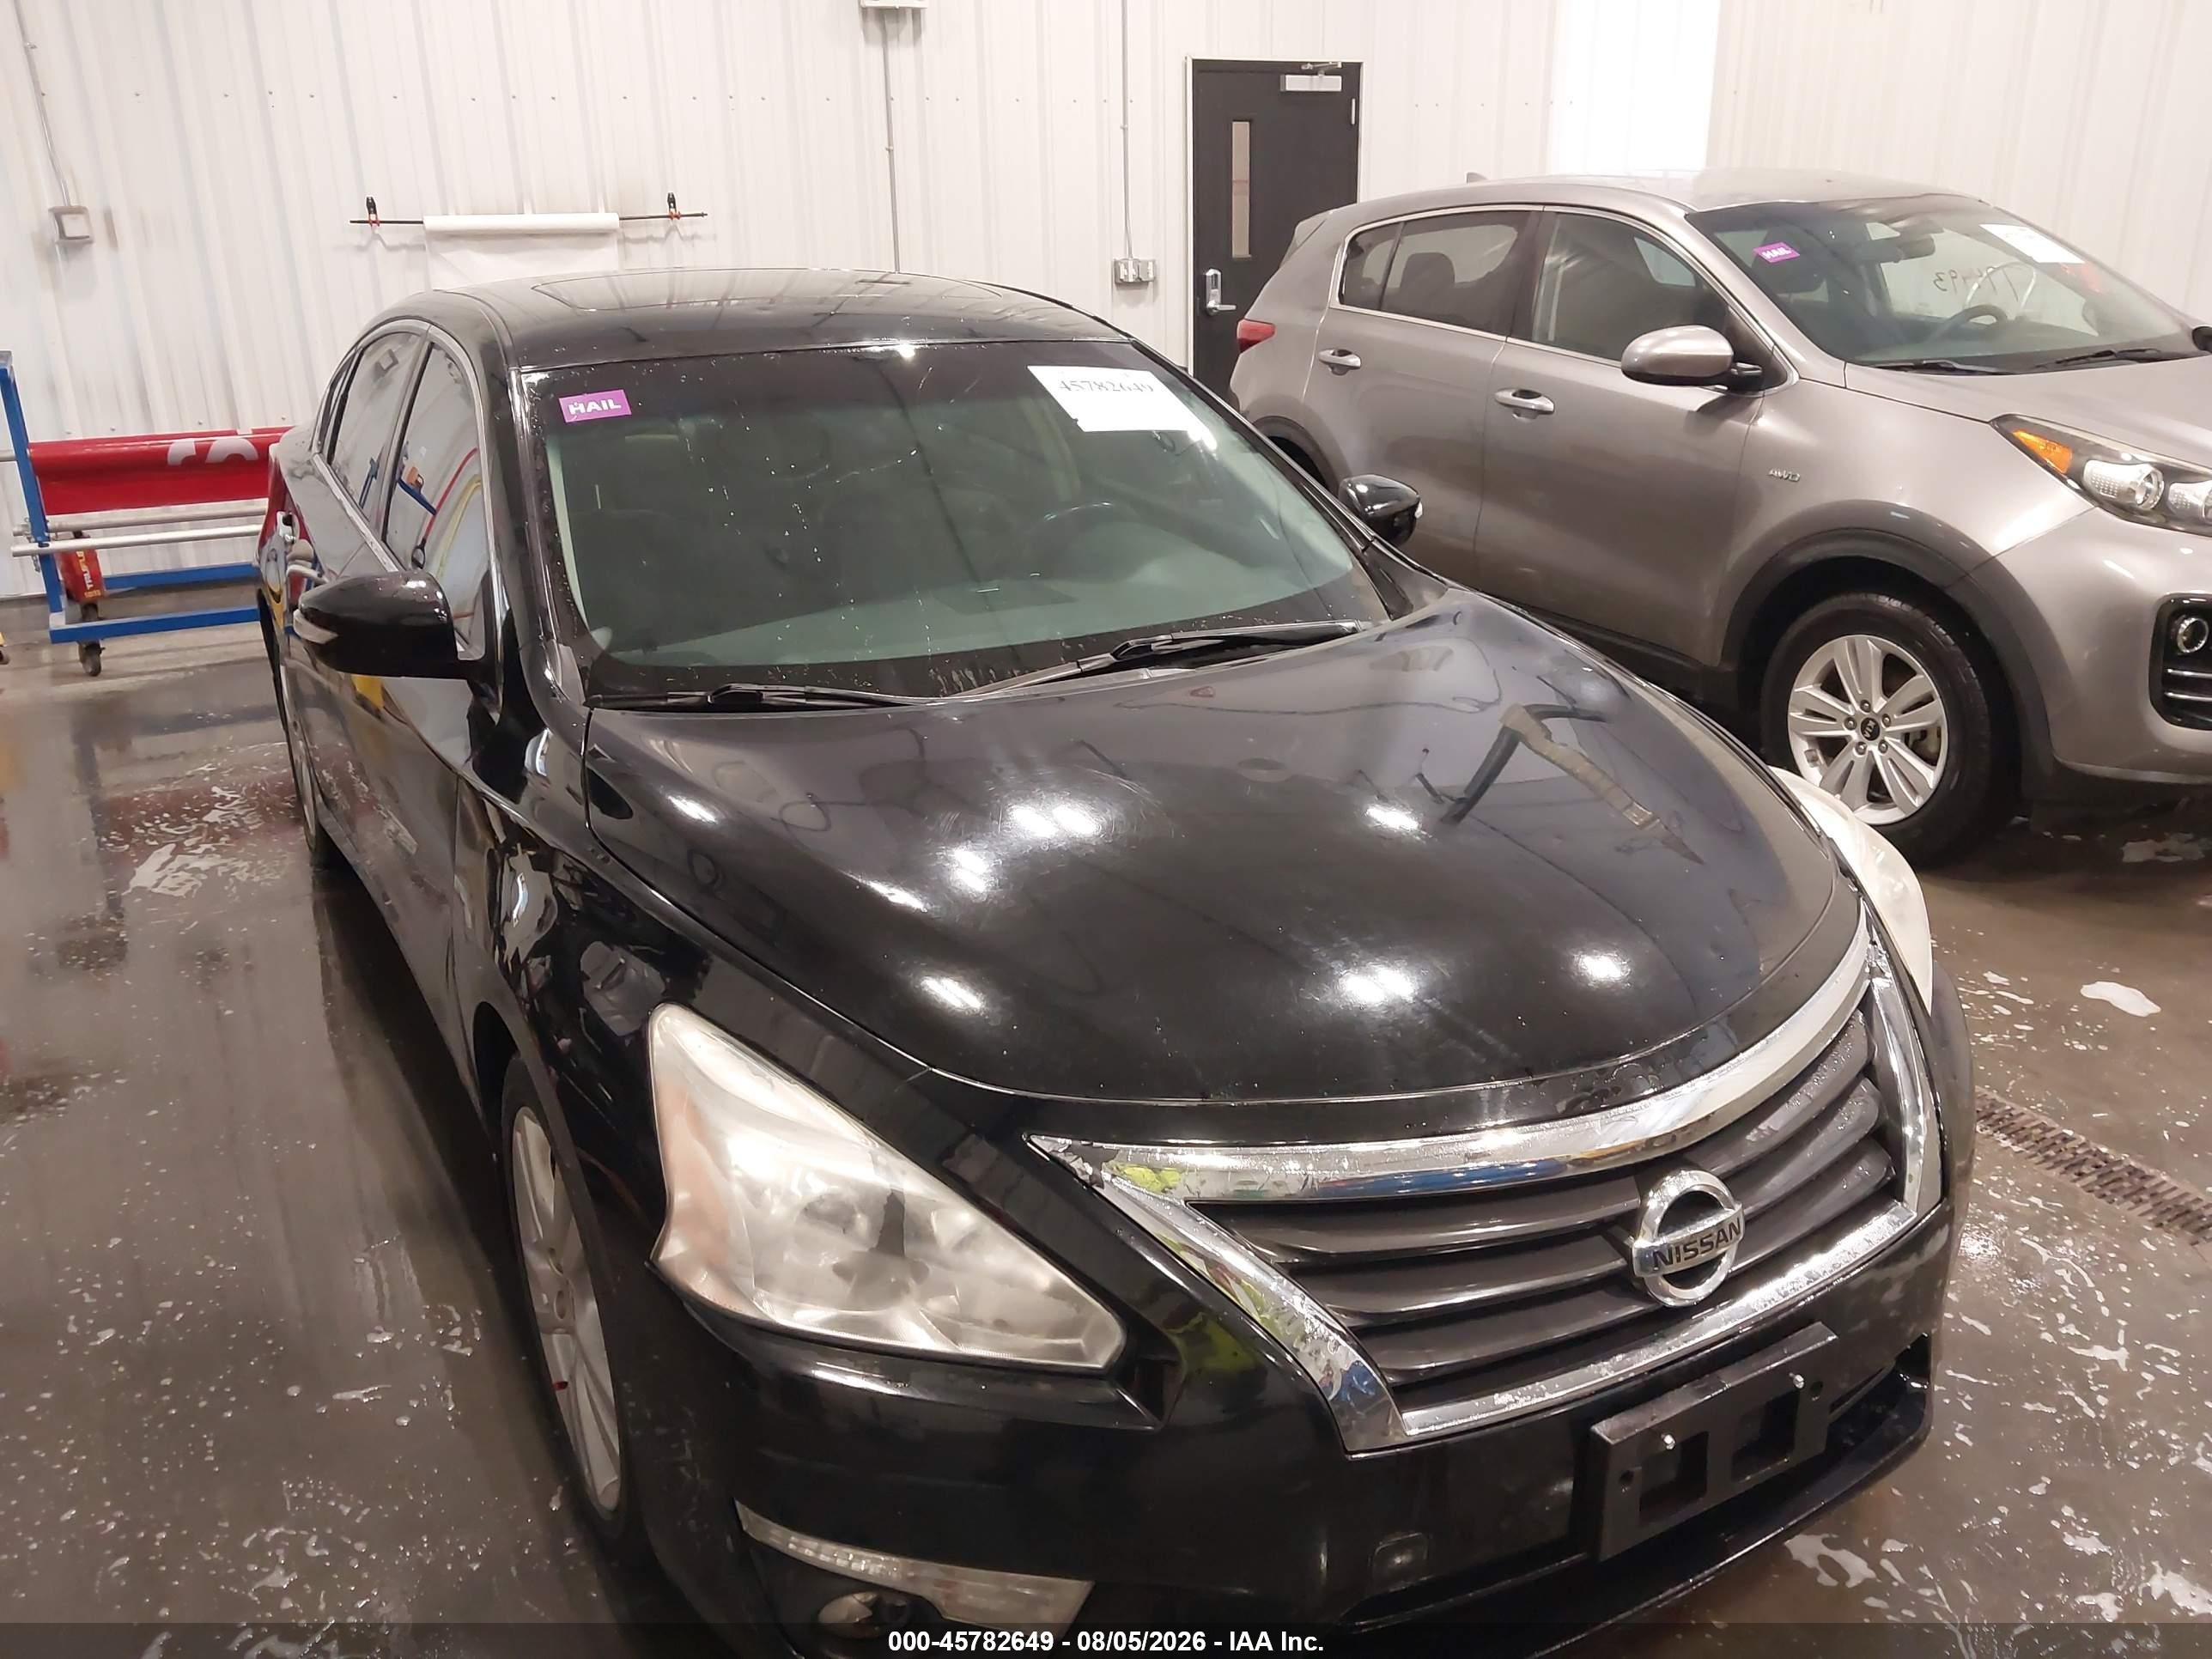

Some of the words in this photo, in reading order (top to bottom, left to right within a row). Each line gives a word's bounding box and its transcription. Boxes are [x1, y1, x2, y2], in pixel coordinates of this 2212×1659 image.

[1761, 246, 1792, 259] HAIL
[568, 398, 622, 415] HAIL
[1769, 469, 1801, 482] AWD
[1652, 1216, 1741, 1270] NISSAN
